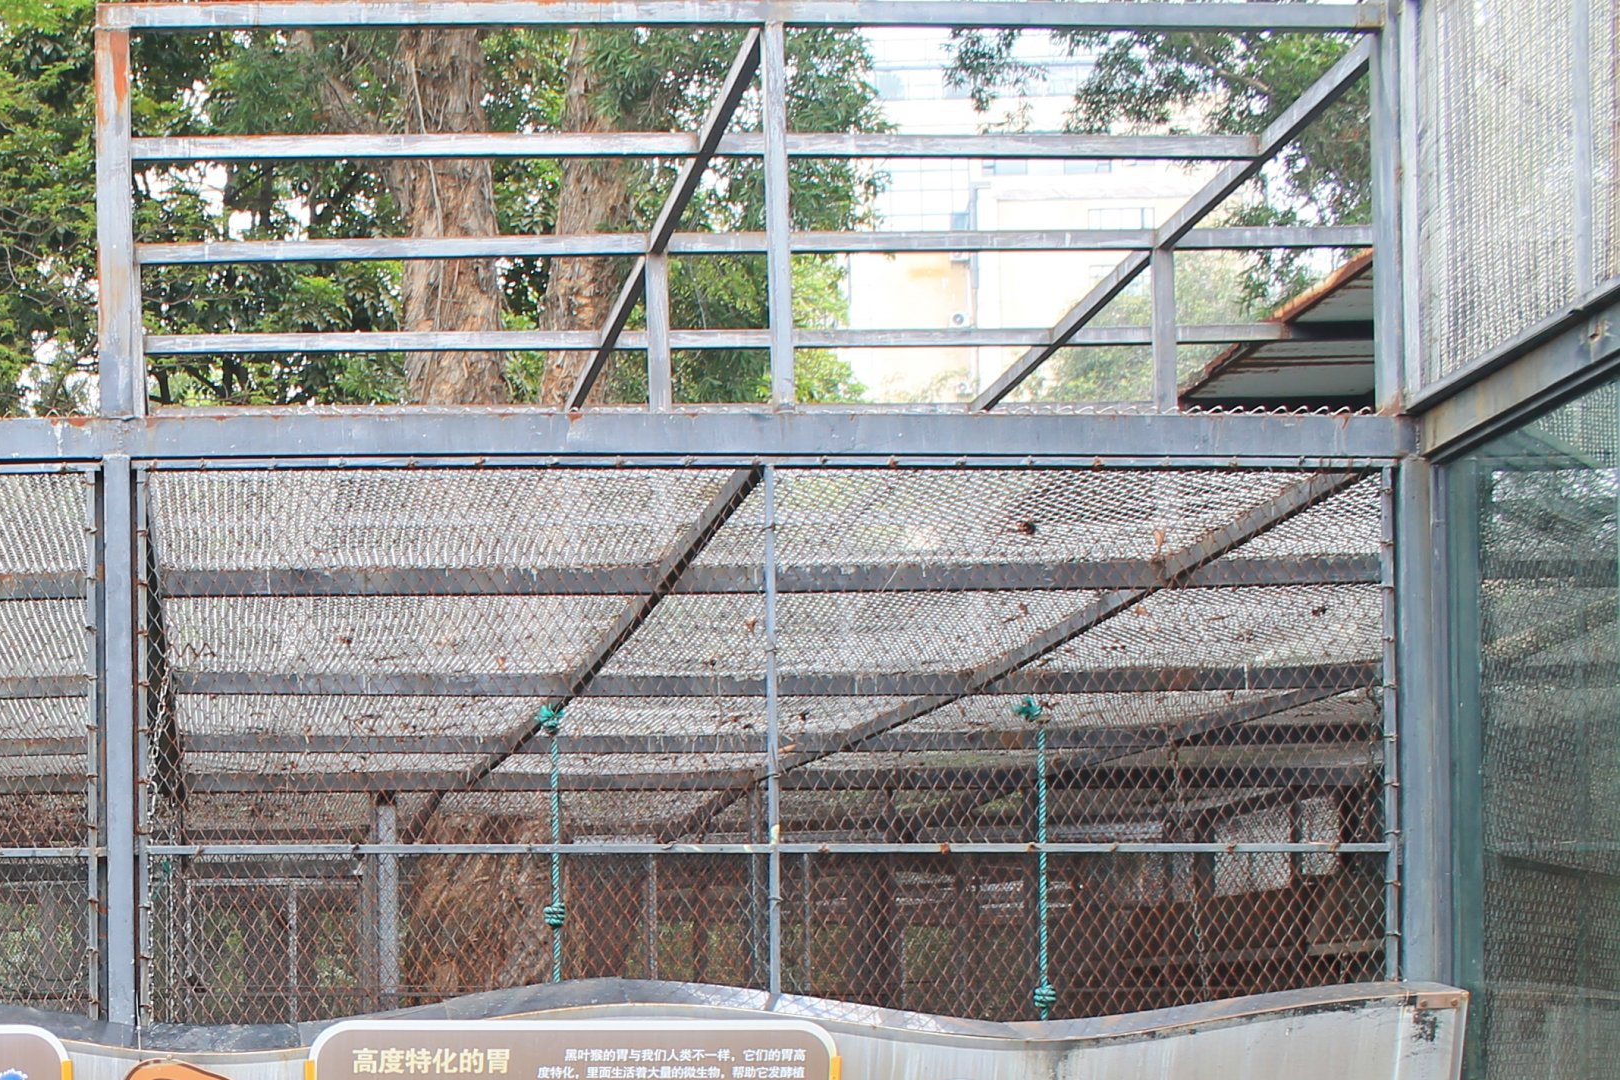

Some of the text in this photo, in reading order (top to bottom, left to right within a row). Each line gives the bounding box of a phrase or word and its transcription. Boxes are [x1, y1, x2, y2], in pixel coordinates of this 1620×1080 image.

[352, 1047, 510, 1074] 高度特化的胃
[564, 1048, 806, 1062] 黑叶猴的胃与我们人类不一样，它们的胃高
[537, 1066, 805, 1079] 度特化，里面生活着大量的微生物，帮助它发酵植
